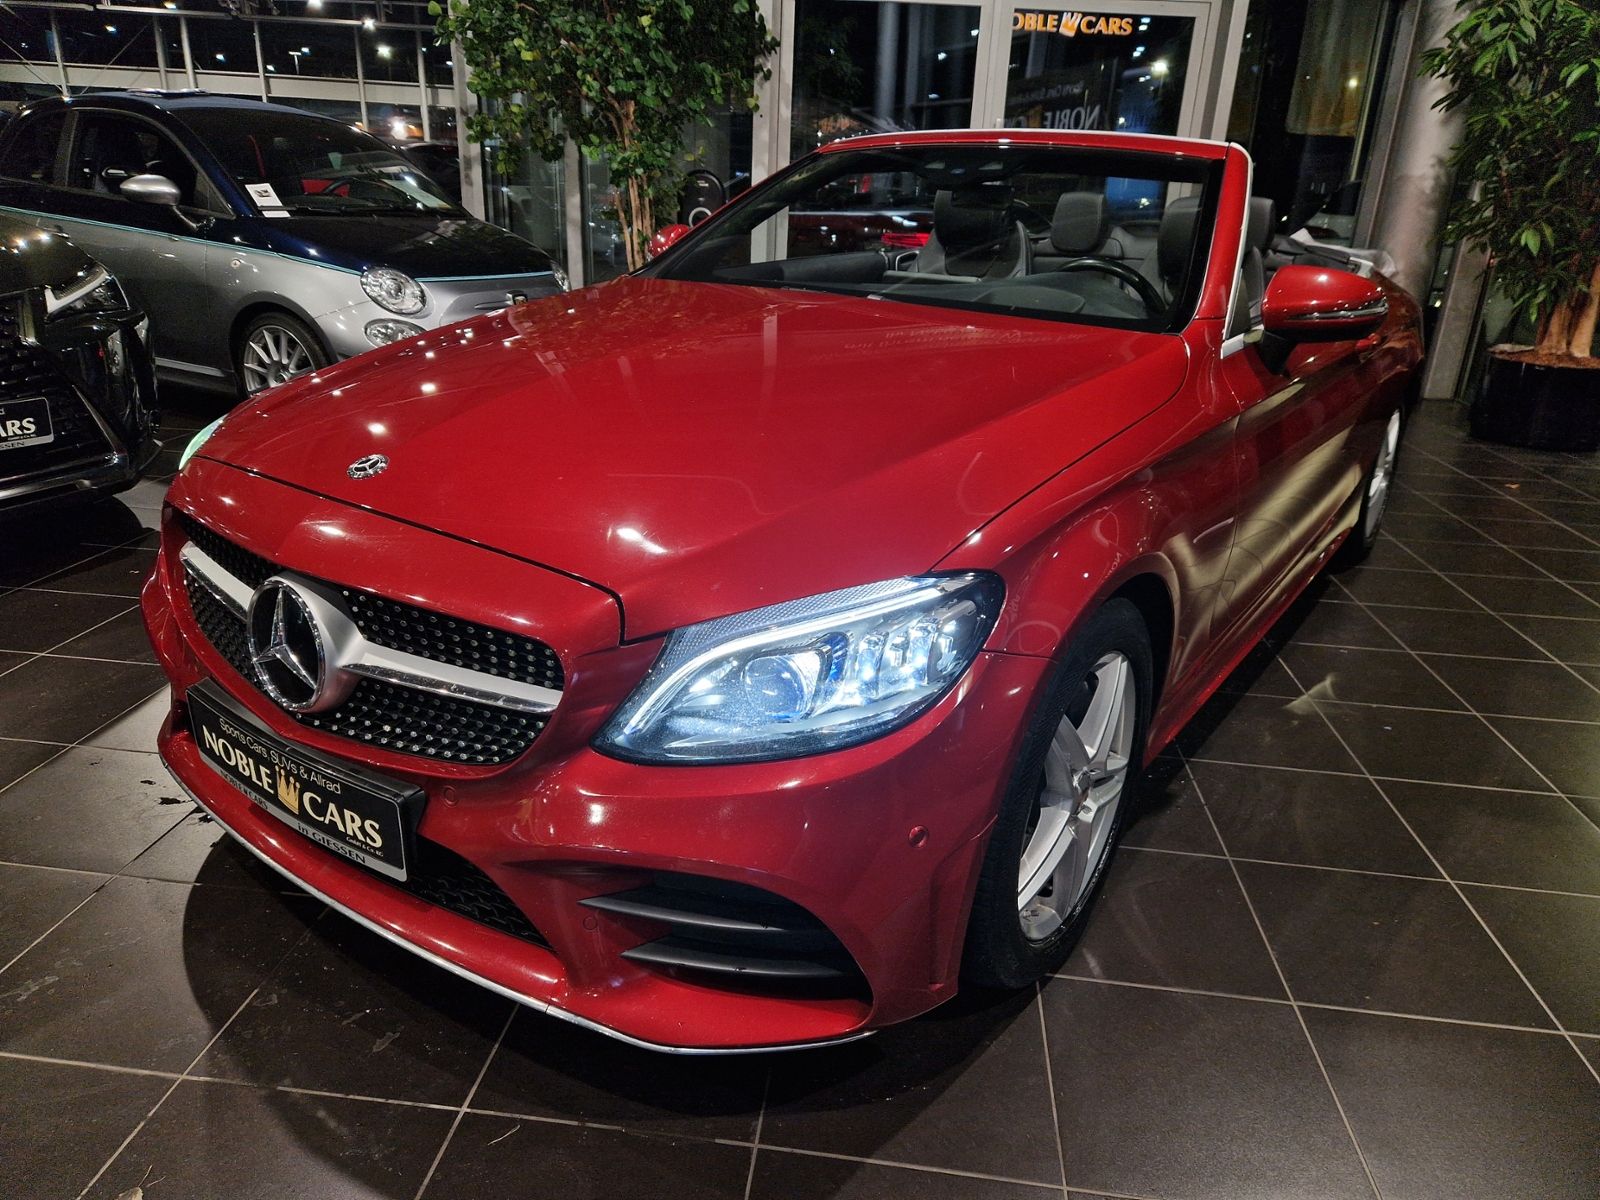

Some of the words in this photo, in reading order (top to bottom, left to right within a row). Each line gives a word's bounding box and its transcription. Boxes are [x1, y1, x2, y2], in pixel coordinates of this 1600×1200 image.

[1080, 15, 1133, 36] CARS
[219, 718, 246, 744] Sports
[269, 749, 298, 774] SUVs
[299, 765, 309, 780] &
[310, 771, 341, 794] Allrad
[202, 724, 275, 794] NOBLE
[302, 791, 383, 848] CARS
[312, 831, 366, 864] GIESSEN
